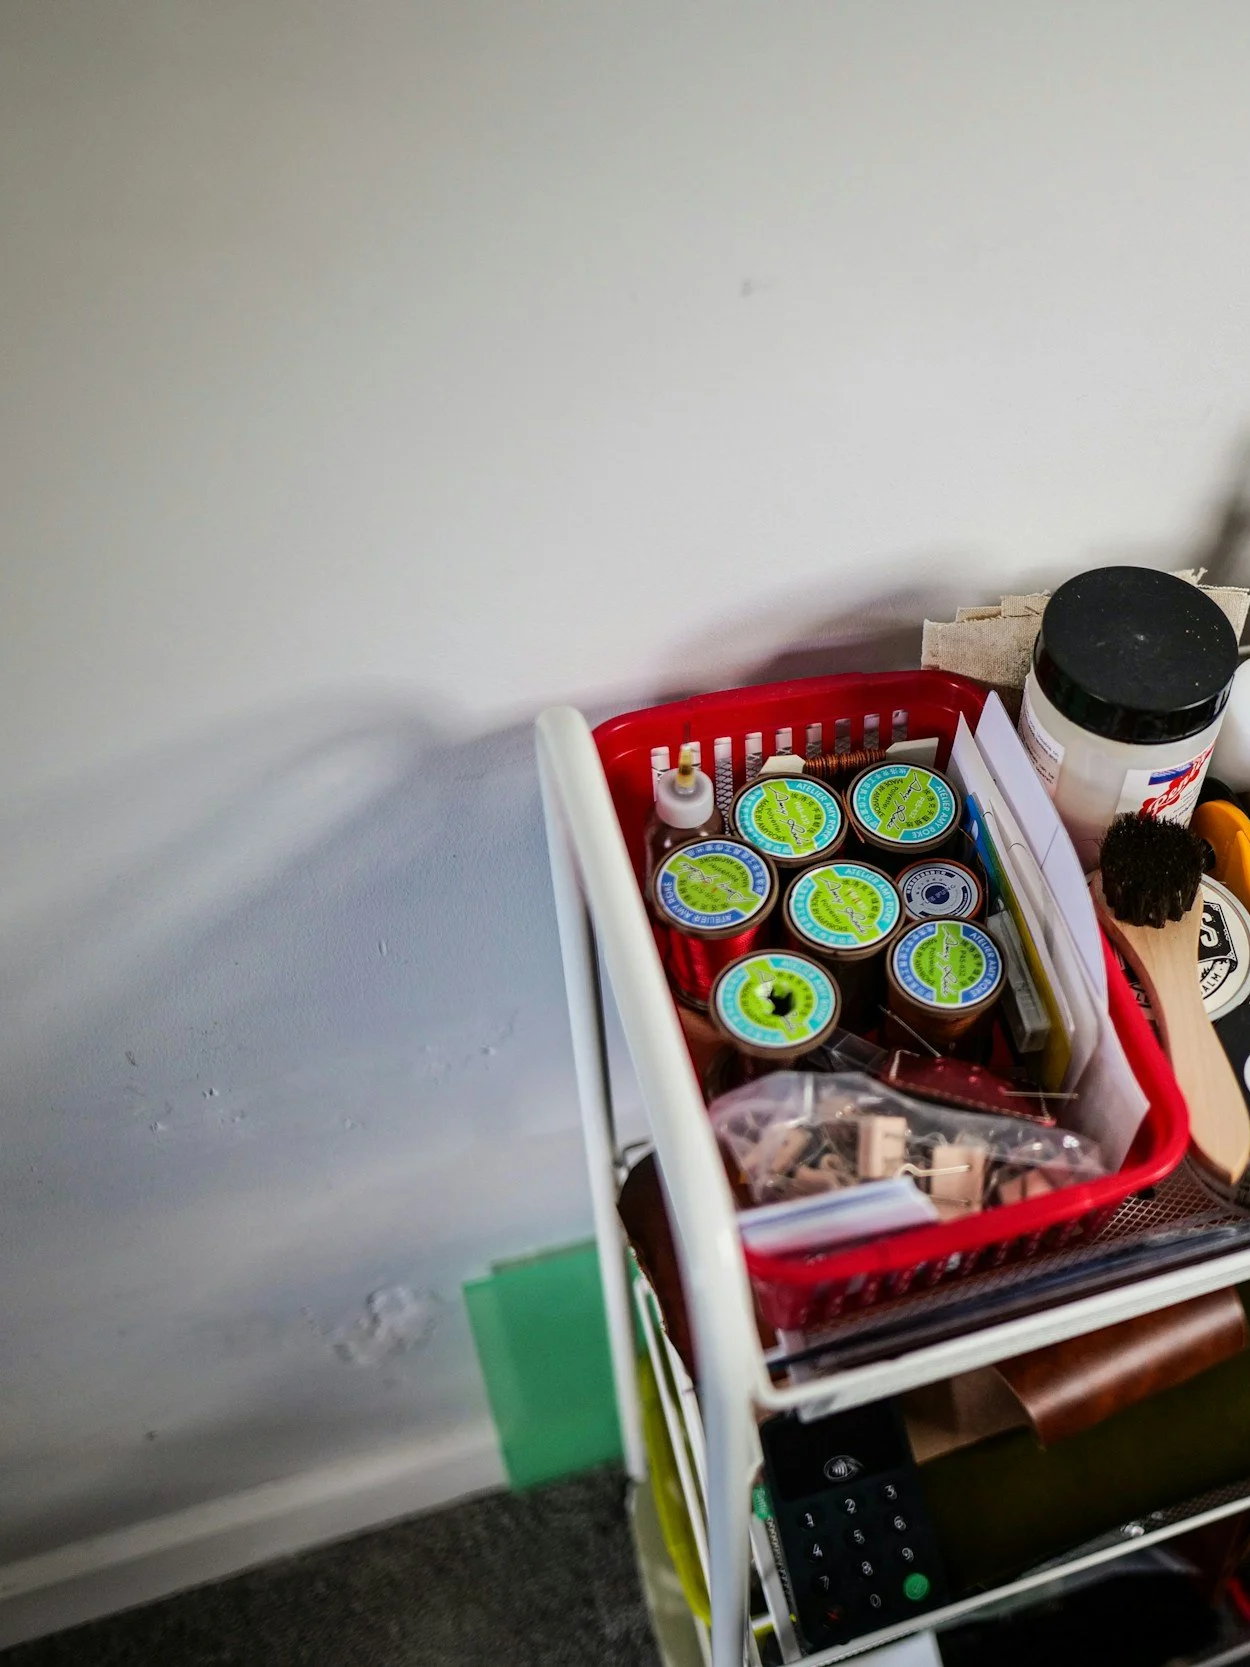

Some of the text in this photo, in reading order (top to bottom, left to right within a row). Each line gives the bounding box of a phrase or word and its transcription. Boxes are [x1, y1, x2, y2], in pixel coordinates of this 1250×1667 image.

[796, 783, 827, 802] ATELIER
[935, 786, 950, 811] ATELIER
[937, 811, 949, 828] AMY
[912, 826, 936, 839] ROKE
[804, 1484, 897, 1528] 1 2 3
[812, 1515, 906, 1557] 4 5 6
[861, 1561, 874, 1576] 8
[901, 1547, 914, 1562] 9
